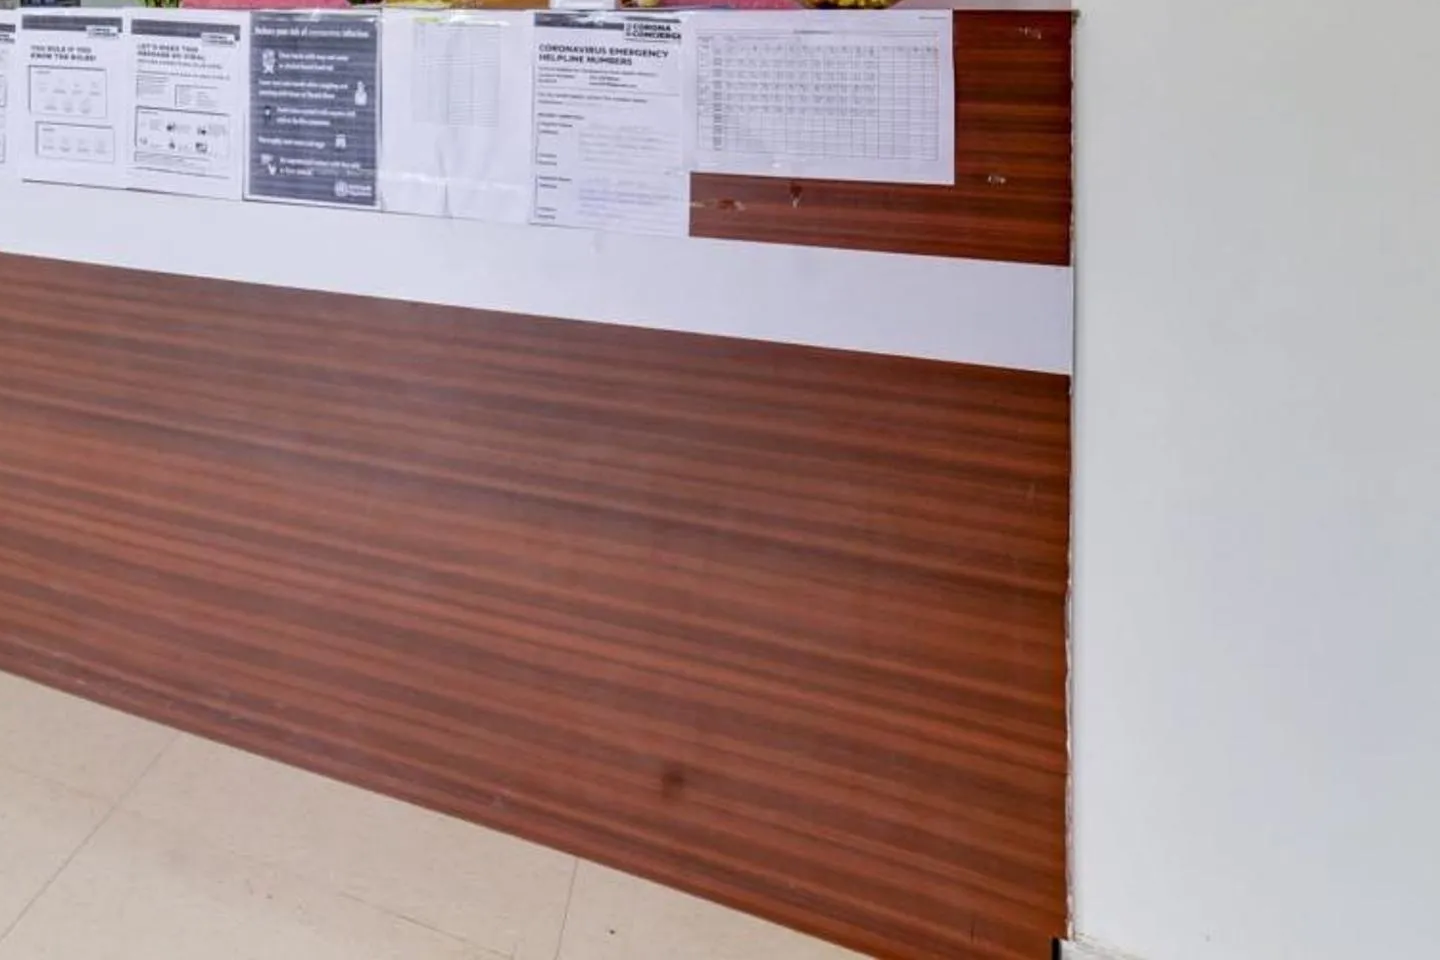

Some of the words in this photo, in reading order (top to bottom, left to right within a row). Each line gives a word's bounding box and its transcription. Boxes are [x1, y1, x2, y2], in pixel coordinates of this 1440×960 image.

[539, 43, 607, 54] CORONAVIRUS
[609, 46, 669, 58] EMERGENCY
[539, 54, 583, 63] HELPLINE
[586, 56, 632, 66] NUMBERS
